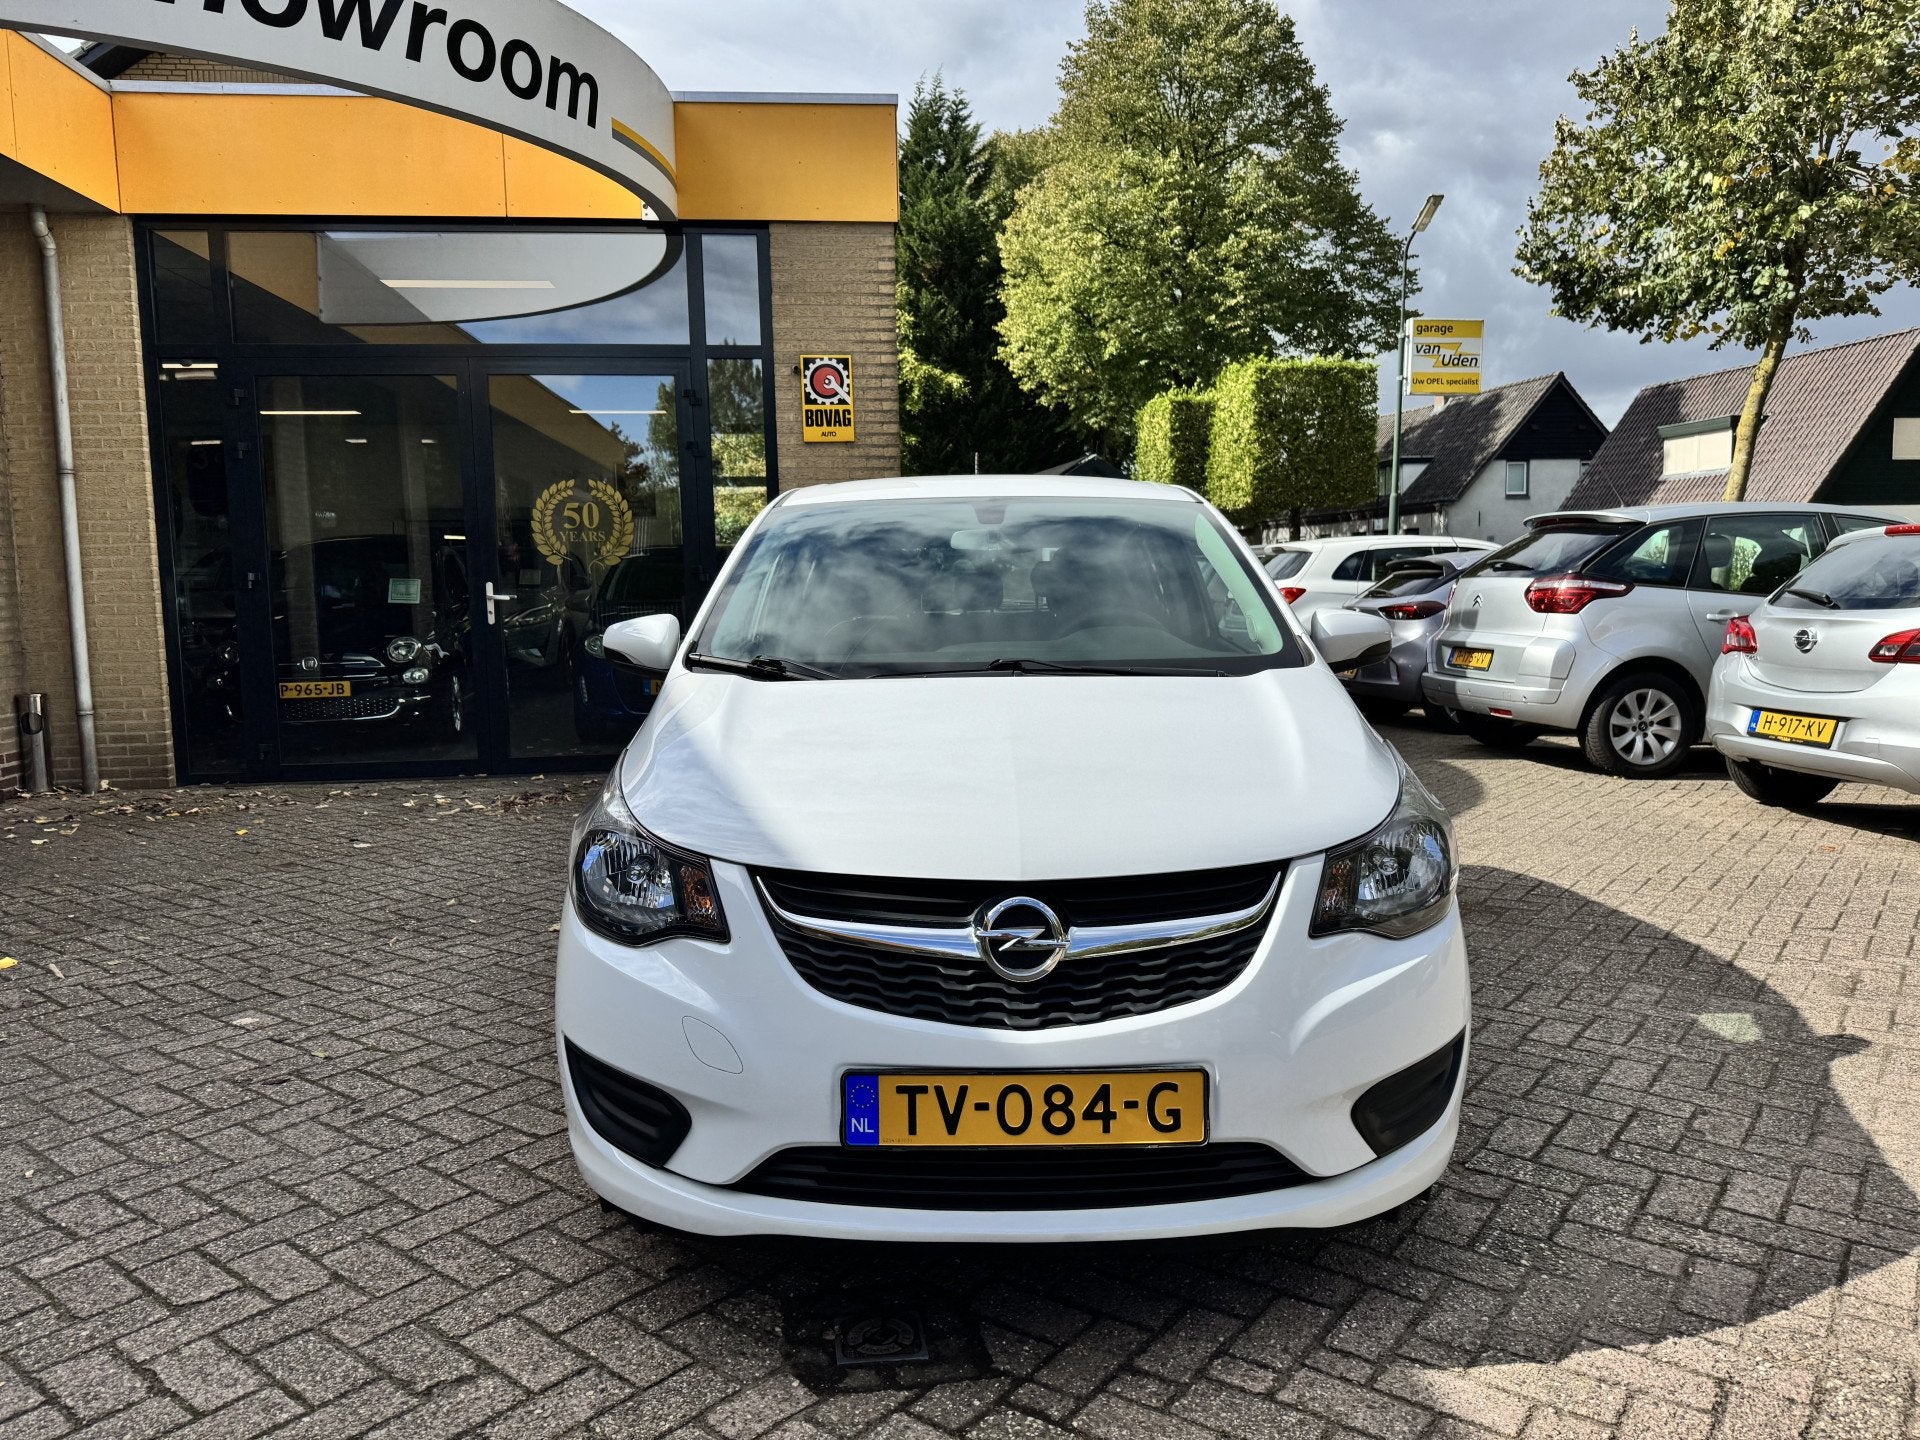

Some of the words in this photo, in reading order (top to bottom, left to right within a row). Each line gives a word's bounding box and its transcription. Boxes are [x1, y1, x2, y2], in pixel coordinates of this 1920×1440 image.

[1416, 324, 1453, 334] garage
[1415, 344, 1441, 355] van
[1441, 354, 1479, 367] Uden
[1446, 378, 1479, 386] specialist
[804, 409, 852, 427] BOVAG
[563, 502, 600, 529] 50
[559, 531, 606, 542] YEARS
[280, 683, 345, 697] P-965-JB
[1762, 714, 1828, 738] H-917-KV
[895, 1080, 1183, 1137] TV-084-G
[851, 1117, 875, 1133] NL
